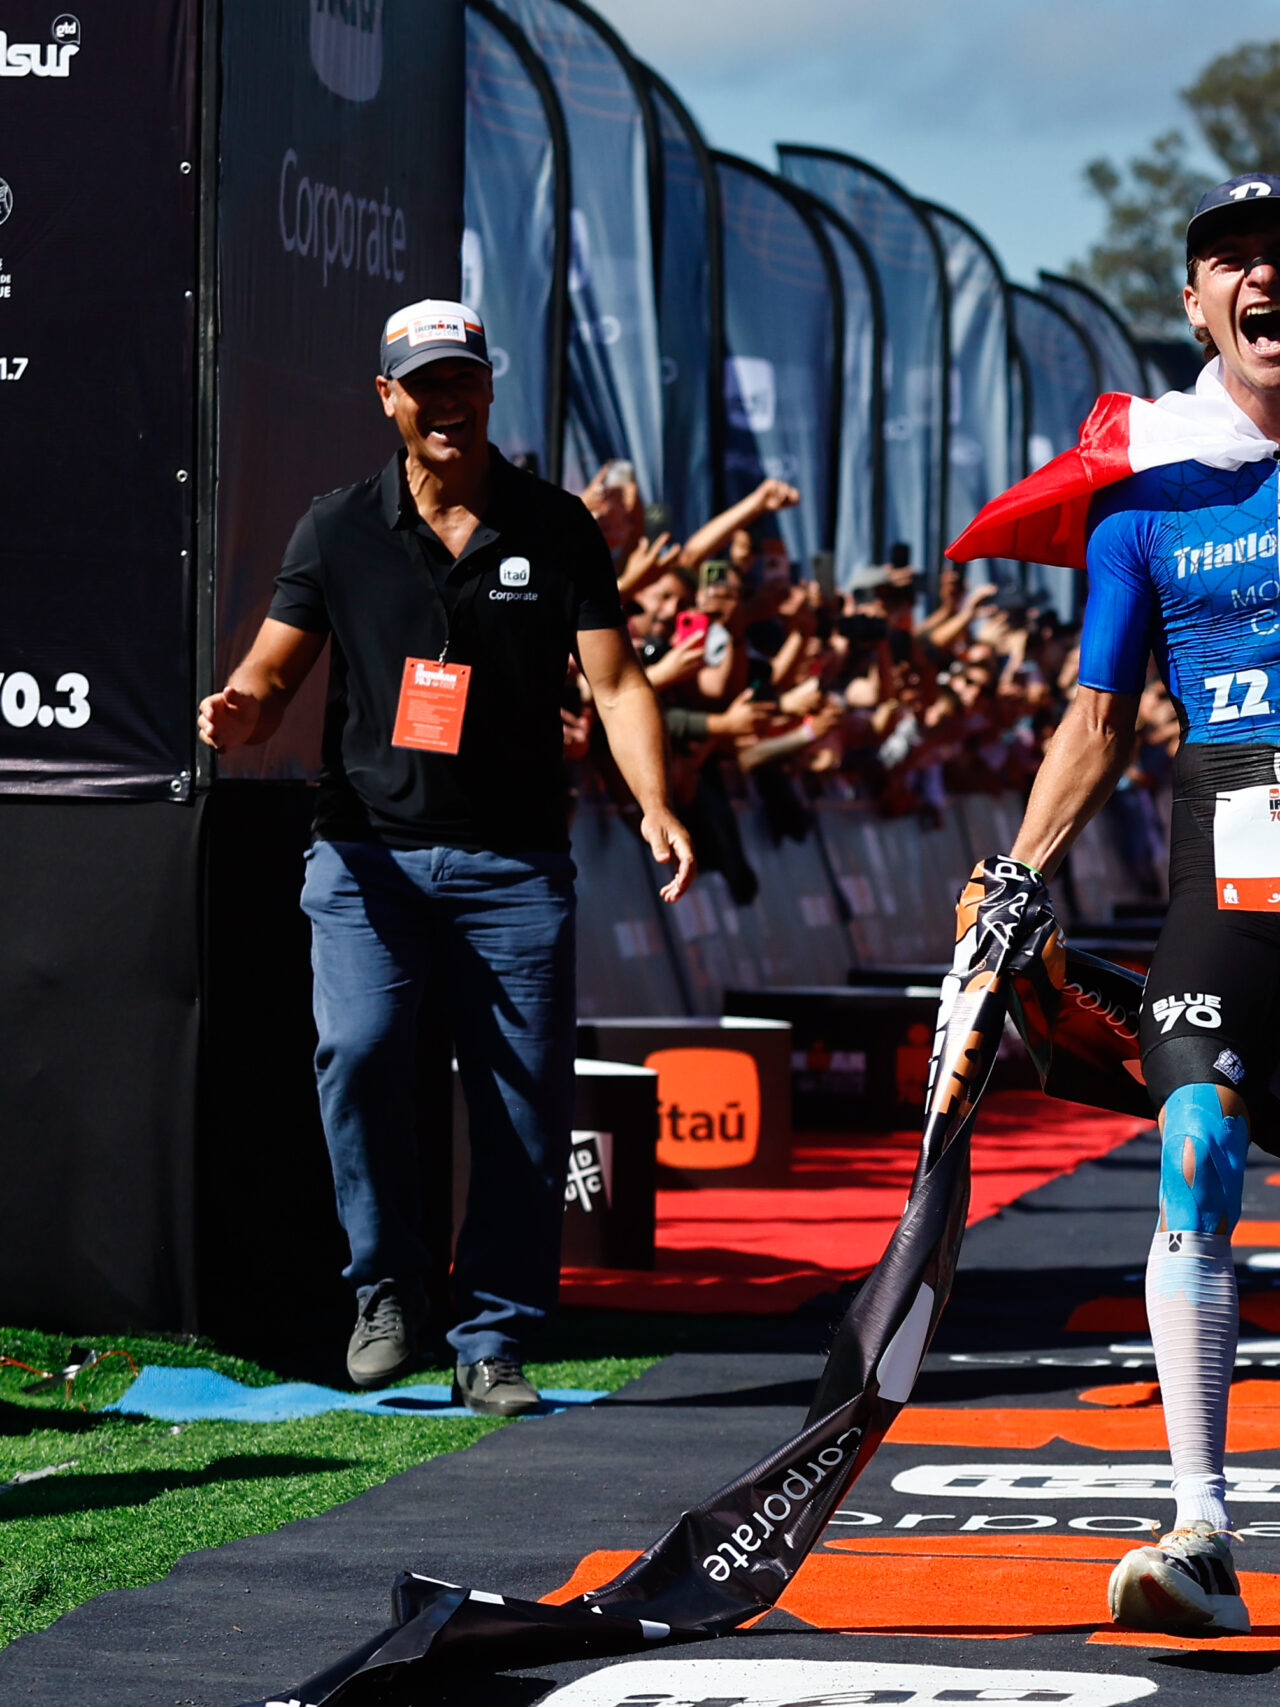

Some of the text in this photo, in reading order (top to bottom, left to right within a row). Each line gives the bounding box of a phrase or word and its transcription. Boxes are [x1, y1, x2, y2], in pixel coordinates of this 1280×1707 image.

[56, 21, 76, 38] gtd
[278, 147, 407, 287] Corporate
[488, 589, 539, 602] Corporate
[0, 671, 92, 728] 0.3
[1152, 992, 1222, 1015] BLUE
[1154, 1006, 1222, 1035] 70
